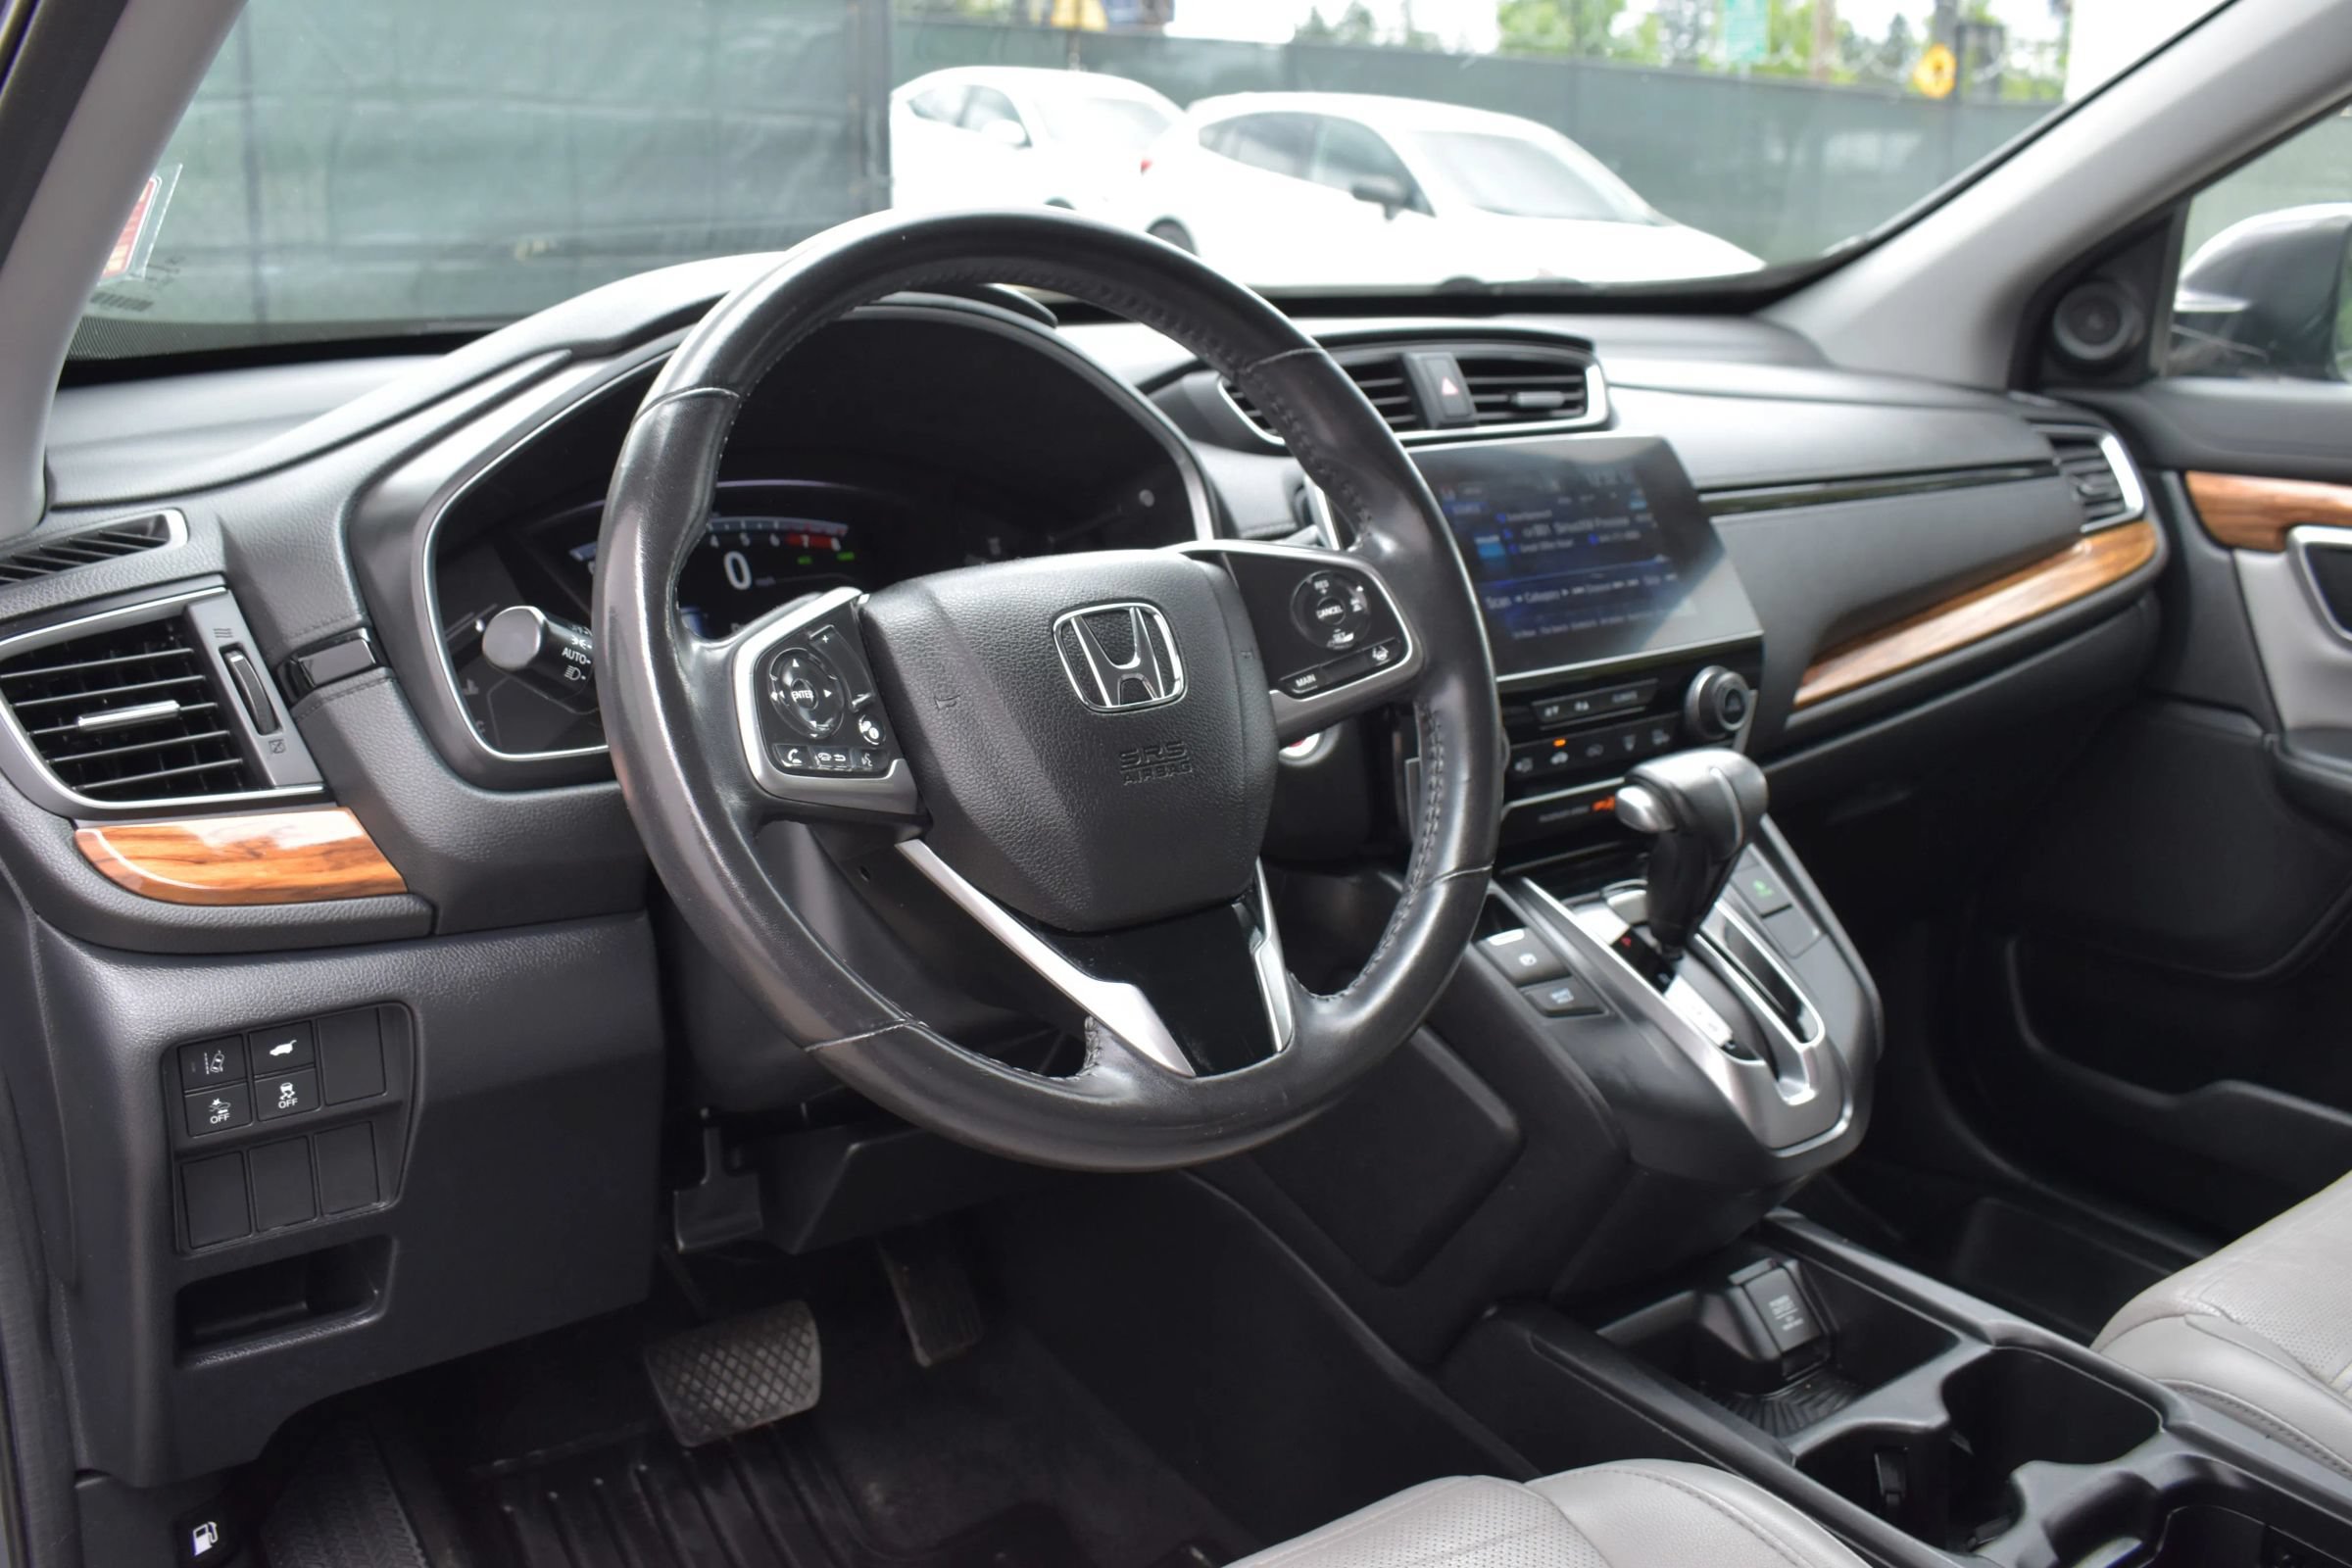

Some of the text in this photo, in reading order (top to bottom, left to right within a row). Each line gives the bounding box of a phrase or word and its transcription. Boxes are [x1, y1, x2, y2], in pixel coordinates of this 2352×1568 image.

[723, 551, 752, 590] 0
[1316, 605, 1343, 619] CANCEL
[1296, 673, 1316, 687] MAIN
[791, 689, 814, 702] ENTER
[1120, 742, 1189, 768] SRS
[1121, 759, 1193, 785] AIRBAG
[277, 1099, 298, 1109] OFF
[210, 1113, 230, 1124] OFF
